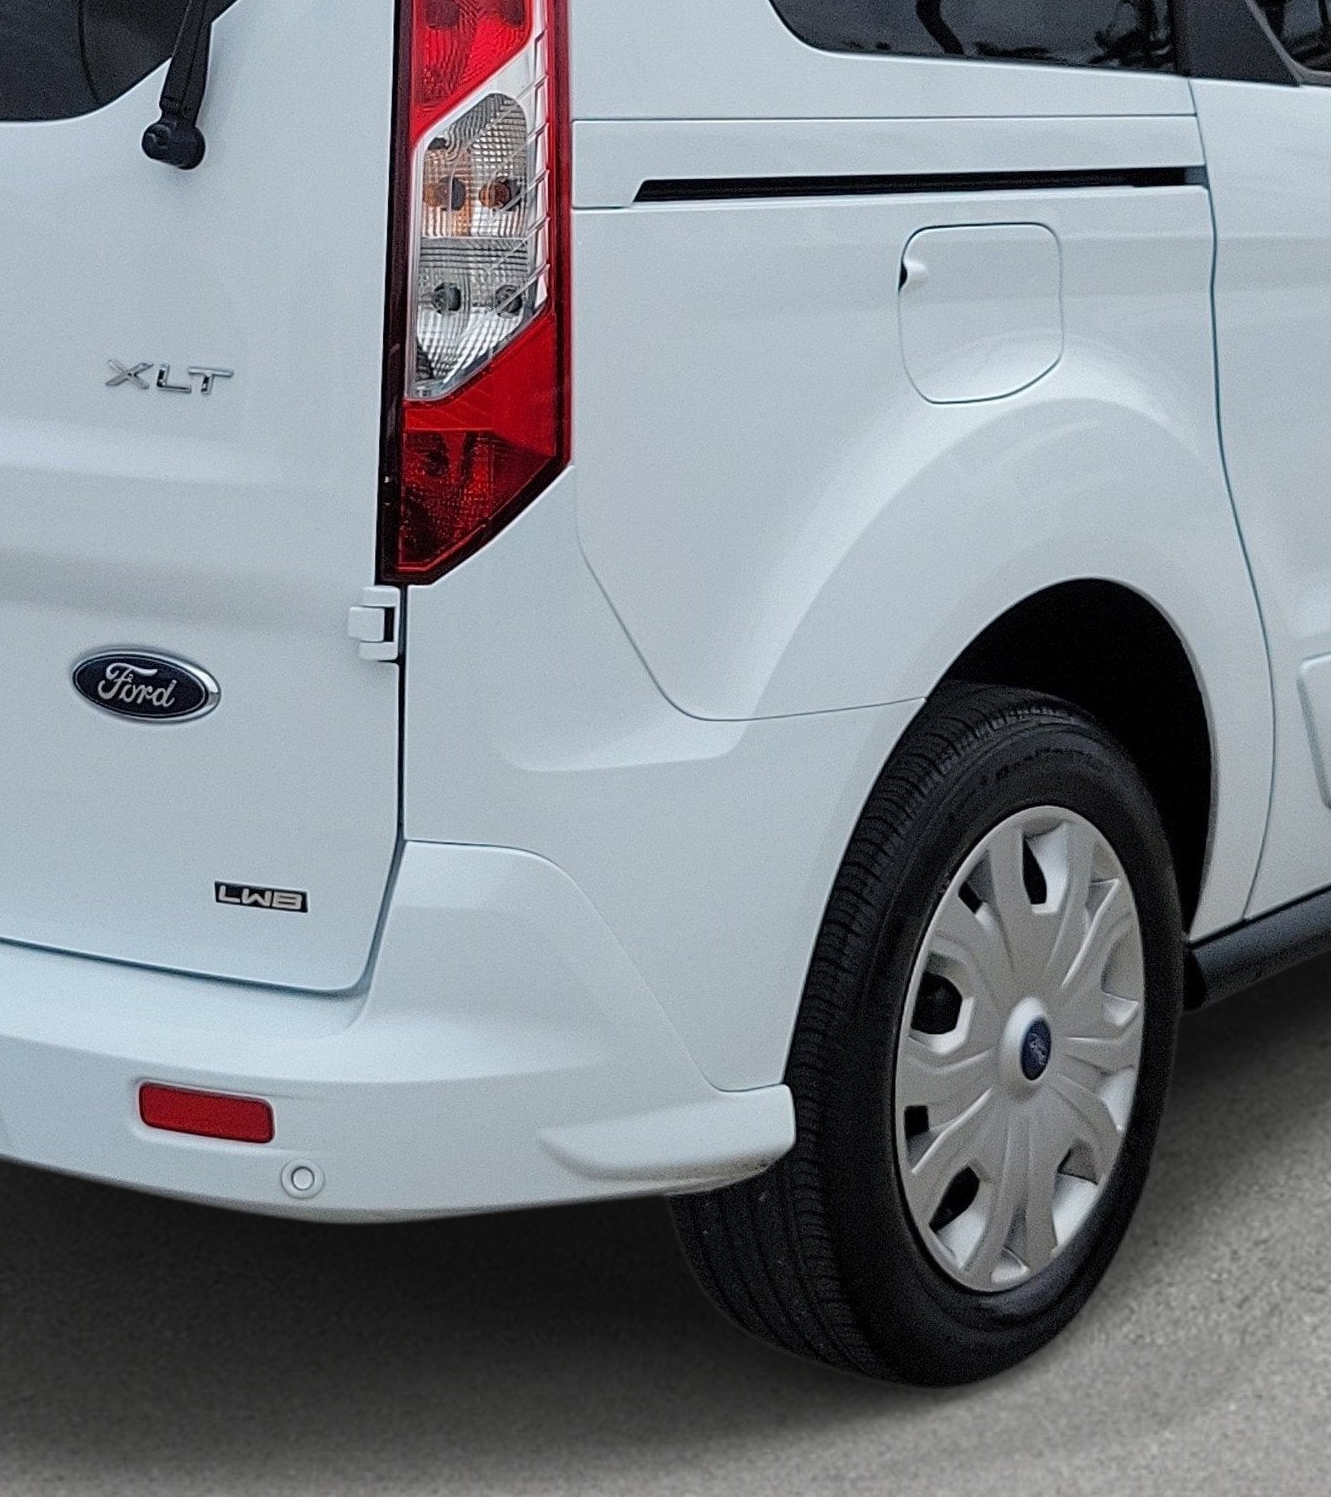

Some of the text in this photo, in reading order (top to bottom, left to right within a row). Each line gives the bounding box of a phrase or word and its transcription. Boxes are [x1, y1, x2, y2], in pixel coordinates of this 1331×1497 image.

[105, 359, 235, 395] XLT
[97, 662, 178, 708] Ford
[218, 885, 303, 910] LWB
